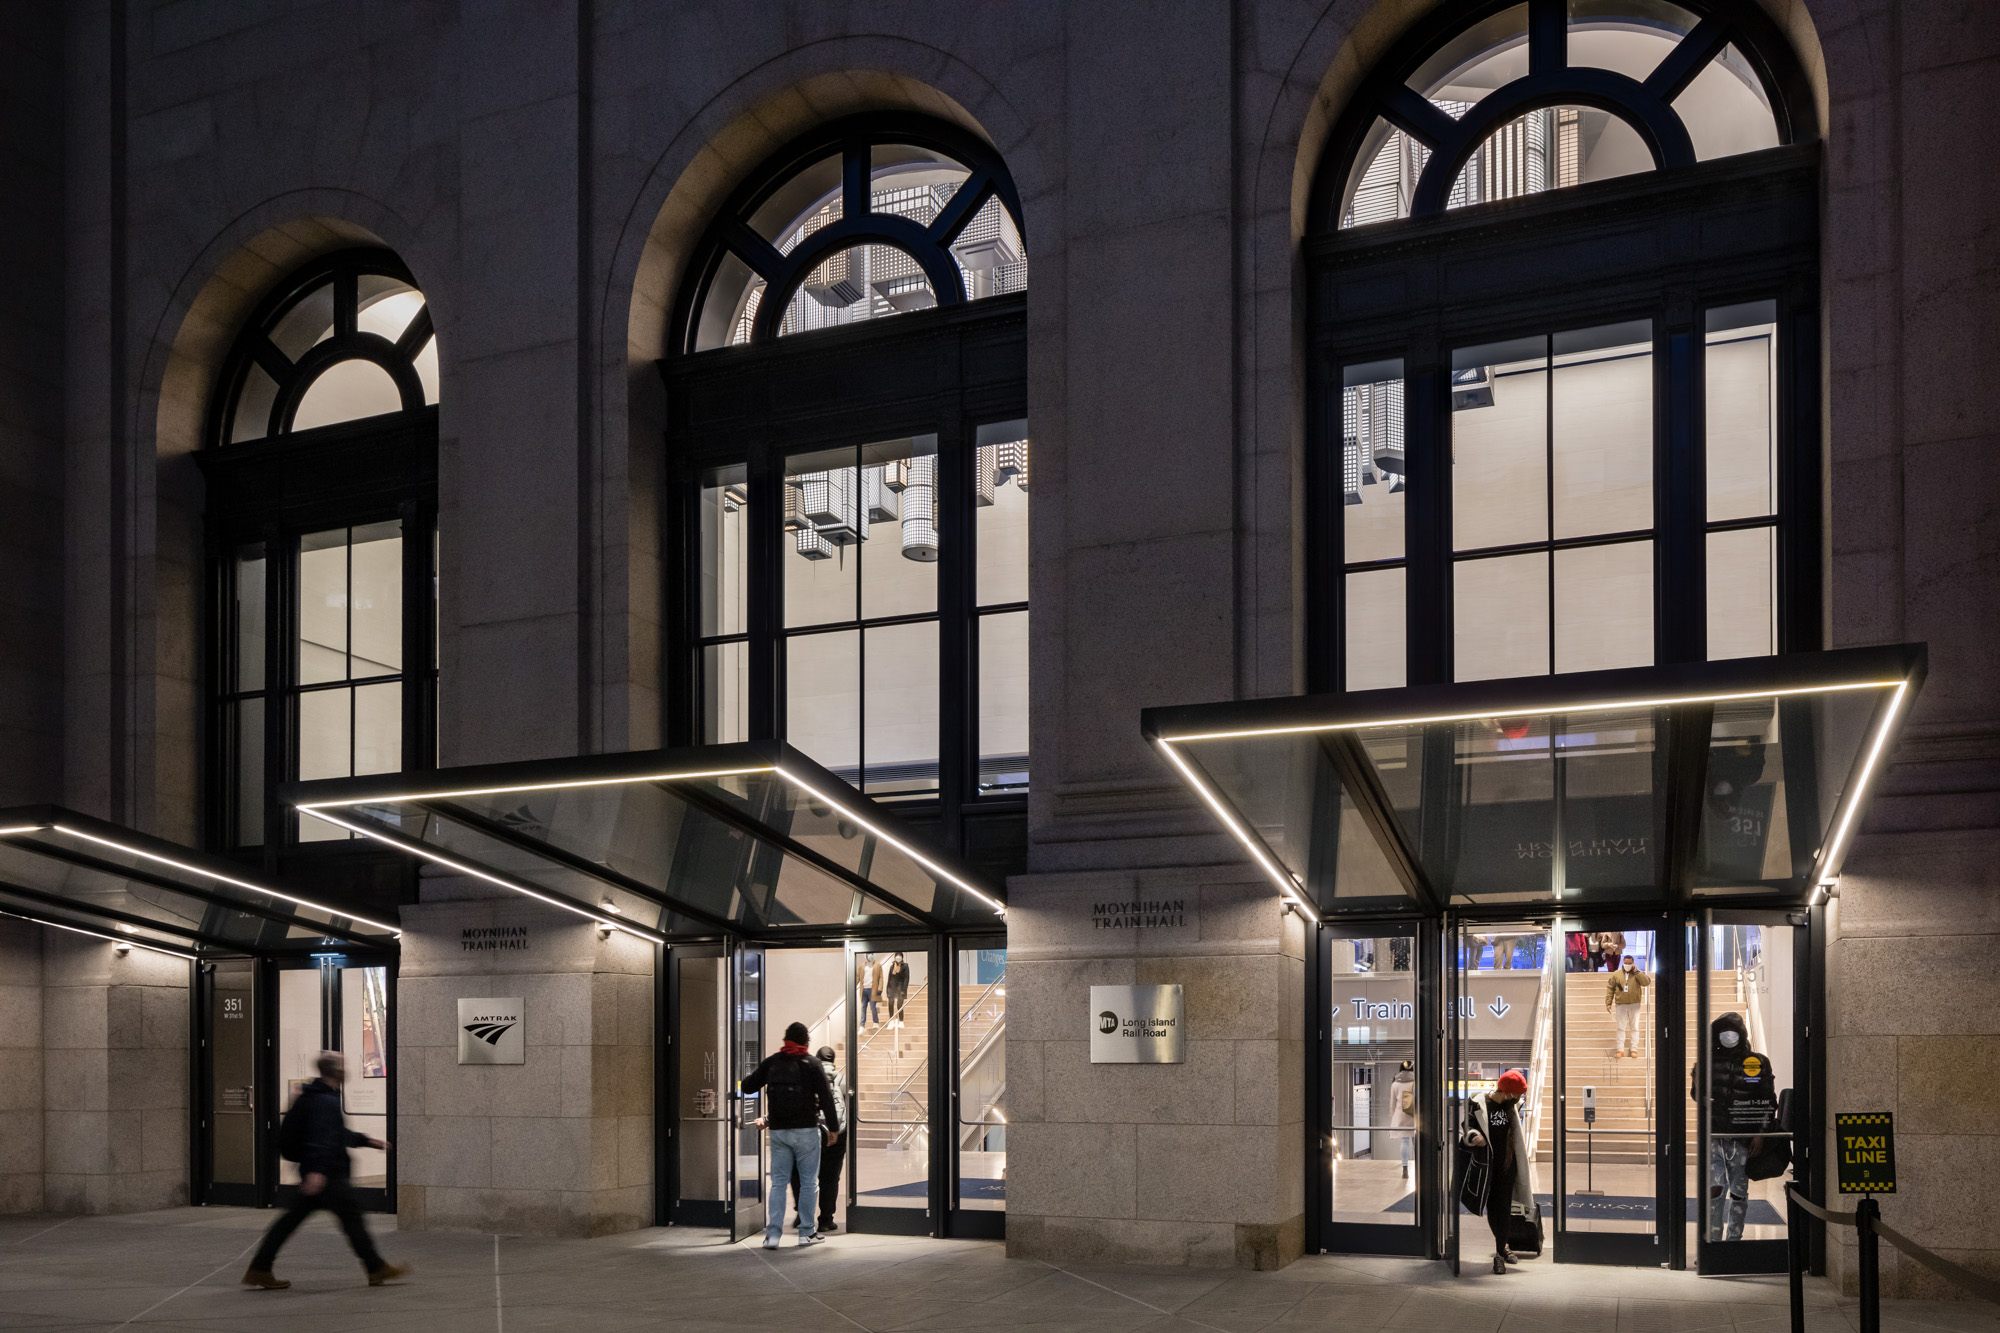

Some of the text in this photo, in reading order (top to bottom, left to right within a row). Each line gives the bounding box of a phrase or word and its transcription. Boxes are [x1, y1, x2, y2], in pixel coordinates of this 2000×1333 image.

[1093, 901, 1184, 915] MOYNIHAN
[1092, 914, 1187, 929] TRAIN HALL
[462, 926, 527, 939] MOYNIHAN
[461, 939, 529, 951] TRAIN HALL
[224, 998, 242, 1011] 351
[1351, 997, 1413, 1020] Train
[1100, 1016, 1115, 1029] MTA
[1122, 1018, 1176, 1028] Long Island
[1122, 1029, 1167, 1038] Rail Road
[1844, 1136, 1886, 1149] TAXI
[1845, 1151, 1887, 1164] LINE
